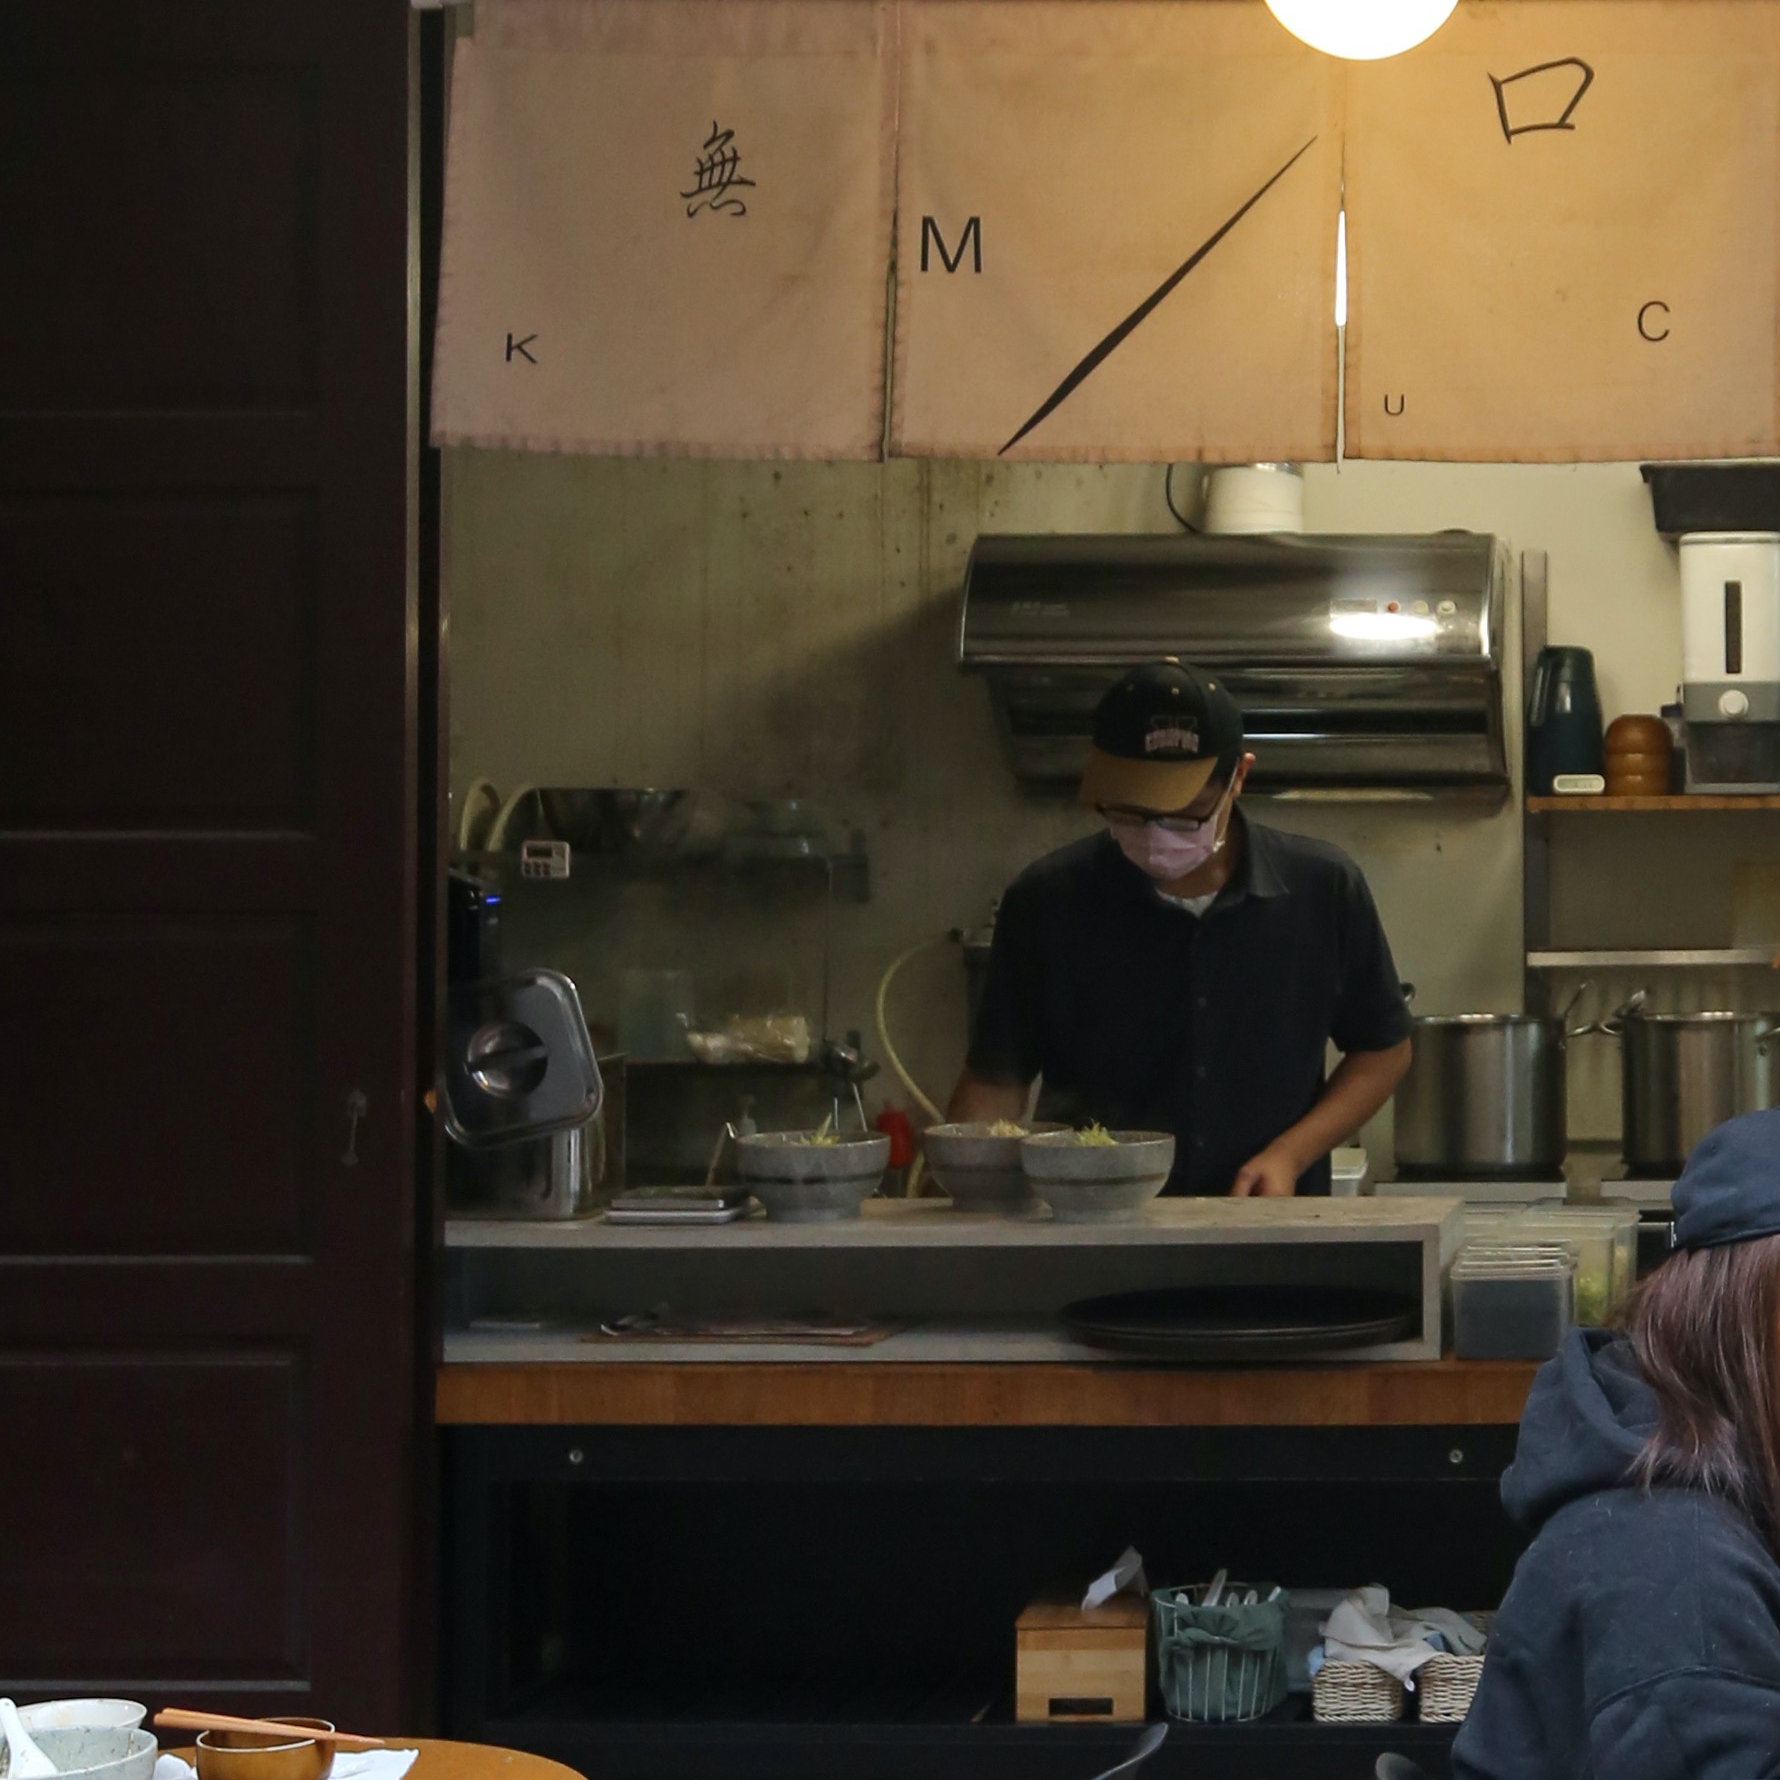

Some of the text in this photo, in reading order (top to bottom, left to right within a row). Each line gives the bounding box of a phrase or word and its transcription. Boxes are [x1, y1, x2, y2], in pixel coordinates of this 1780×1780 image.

[680, 120, 757, 219] 無
[919, 216, 983, 274] M
[1637, 300, 1671, 342] C
[504, 332, 538, 365] K
[1383, 394, 1406, 417] U
